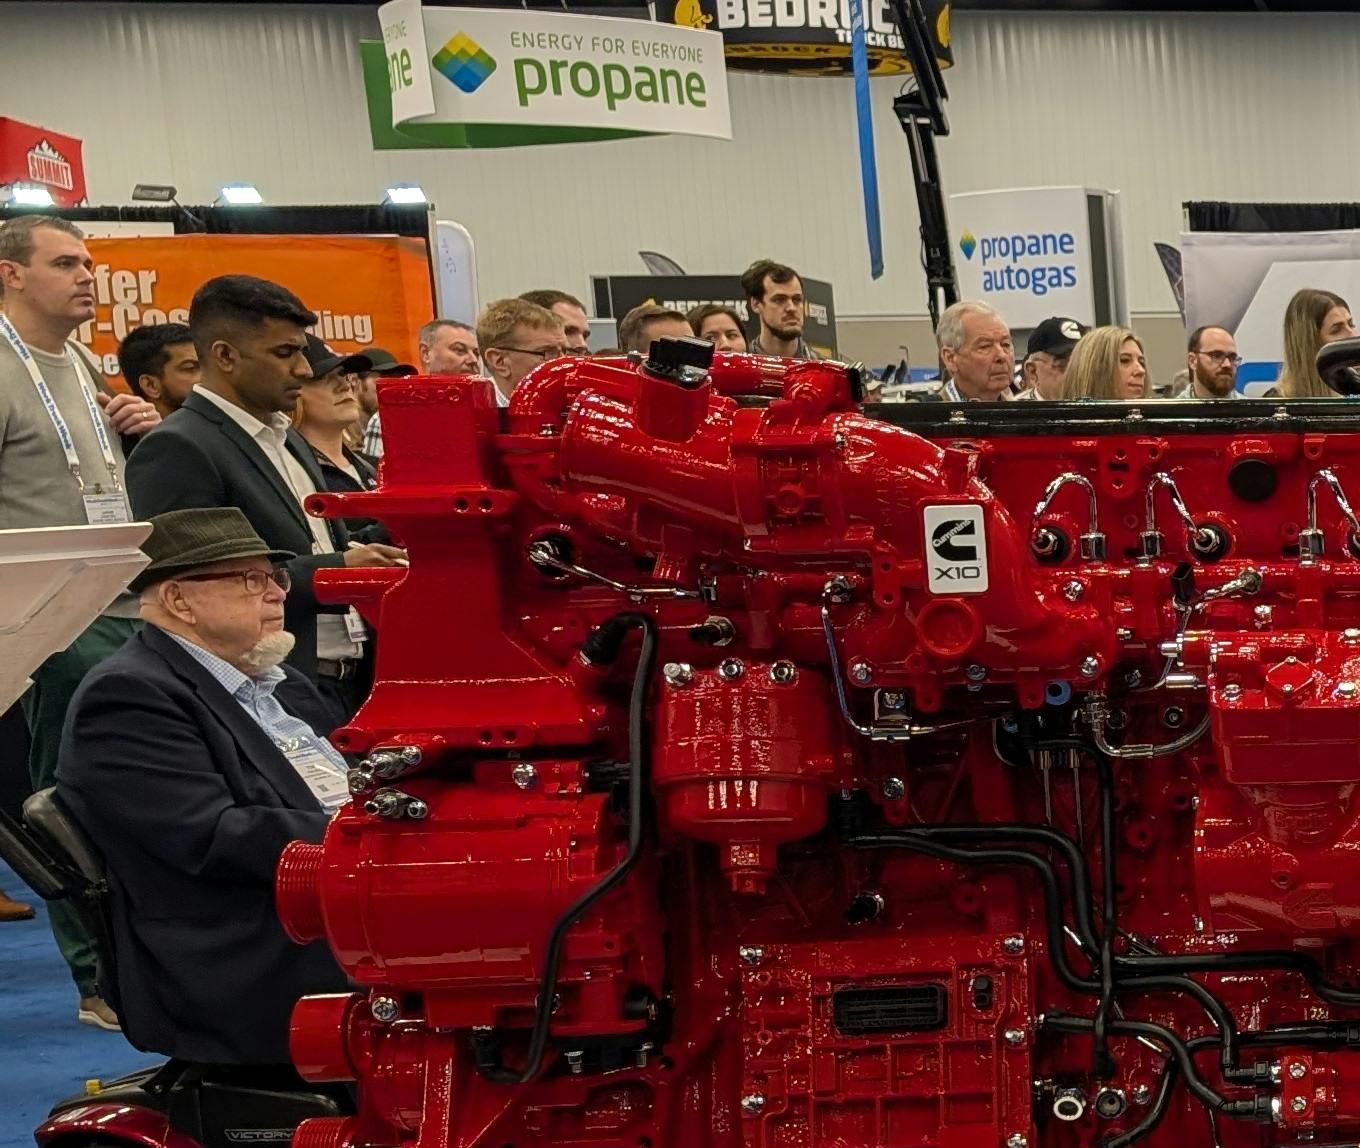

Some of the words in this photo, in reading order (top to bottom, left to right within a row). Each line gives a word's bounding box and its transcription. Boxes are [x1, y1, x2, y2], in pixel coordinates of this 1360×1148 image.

[510, 31, 584, 49] ENERGY
[591, 37, 626, 54] FOR
[631, 39, 703, 63] EVERYONE
[513, 57, 707, 111] propane
[29, 152, 73, 190] SUMMIT
[981, 233, 1074, 264] propane
[94, 264, 156, 304] fer
[983, 265, 1077, 295] autogas
[933, 519, 972, 548] Cummins
[934, 566, 980, 580] X10
[230, 1131, 294, 1139] VICTORY
